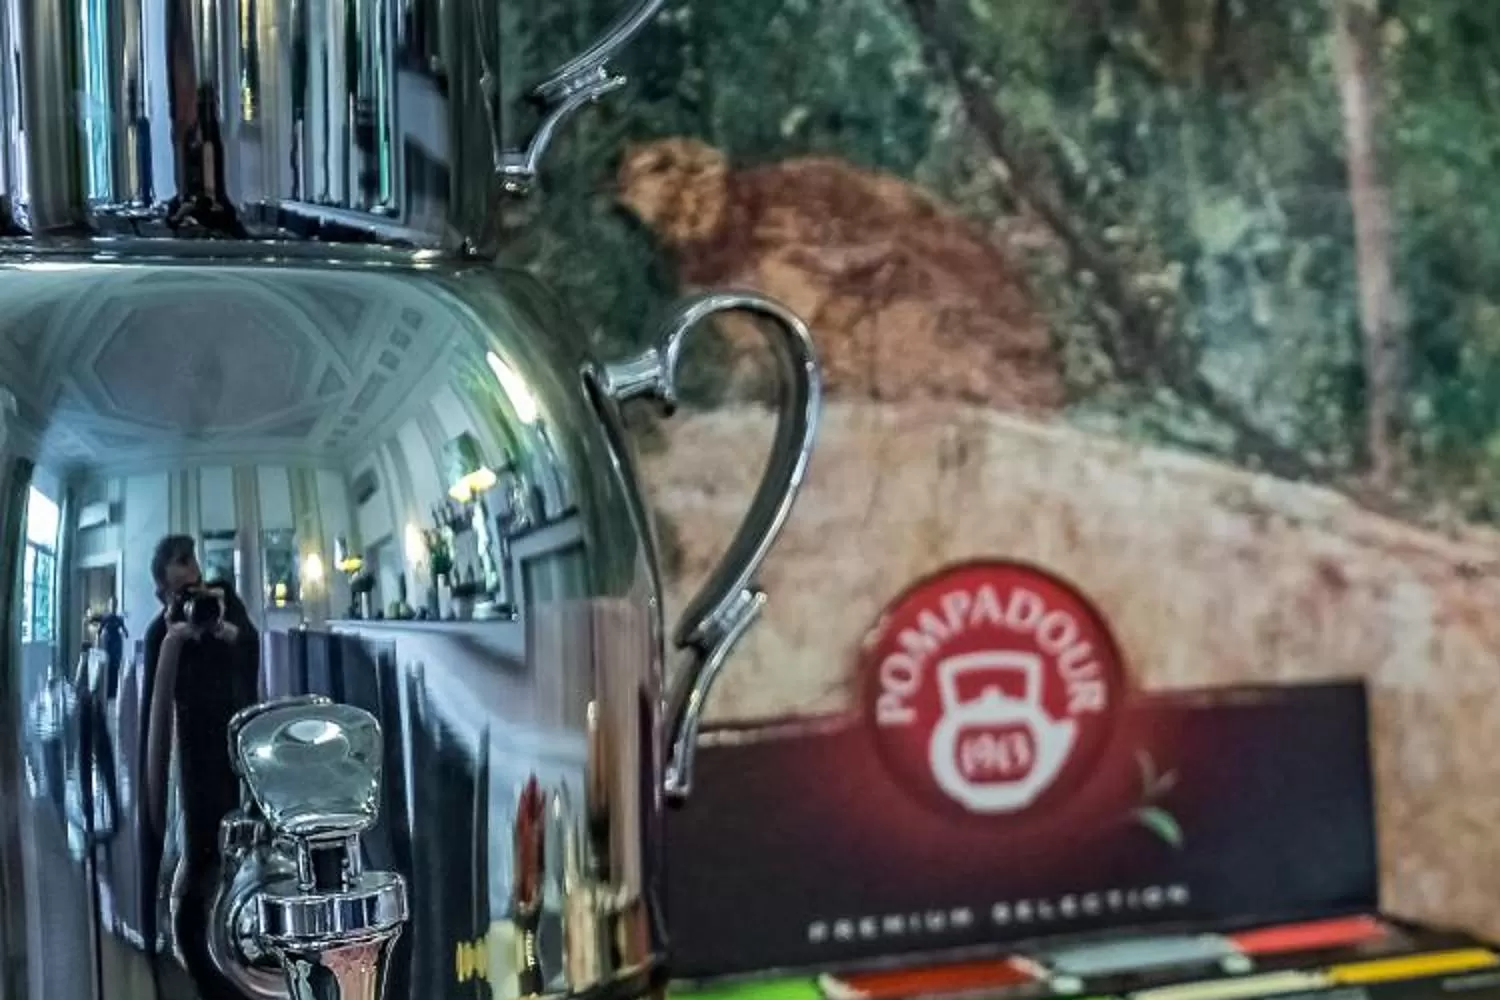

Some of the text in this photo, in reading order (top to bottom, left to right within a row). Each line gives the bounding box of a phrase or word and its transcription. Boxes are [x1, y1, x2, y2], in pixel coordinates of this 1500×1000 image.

[876, 583, 1107, 725] POMPADOUR
[808, 884, 1189, 943] PREMIUM SELECTION
